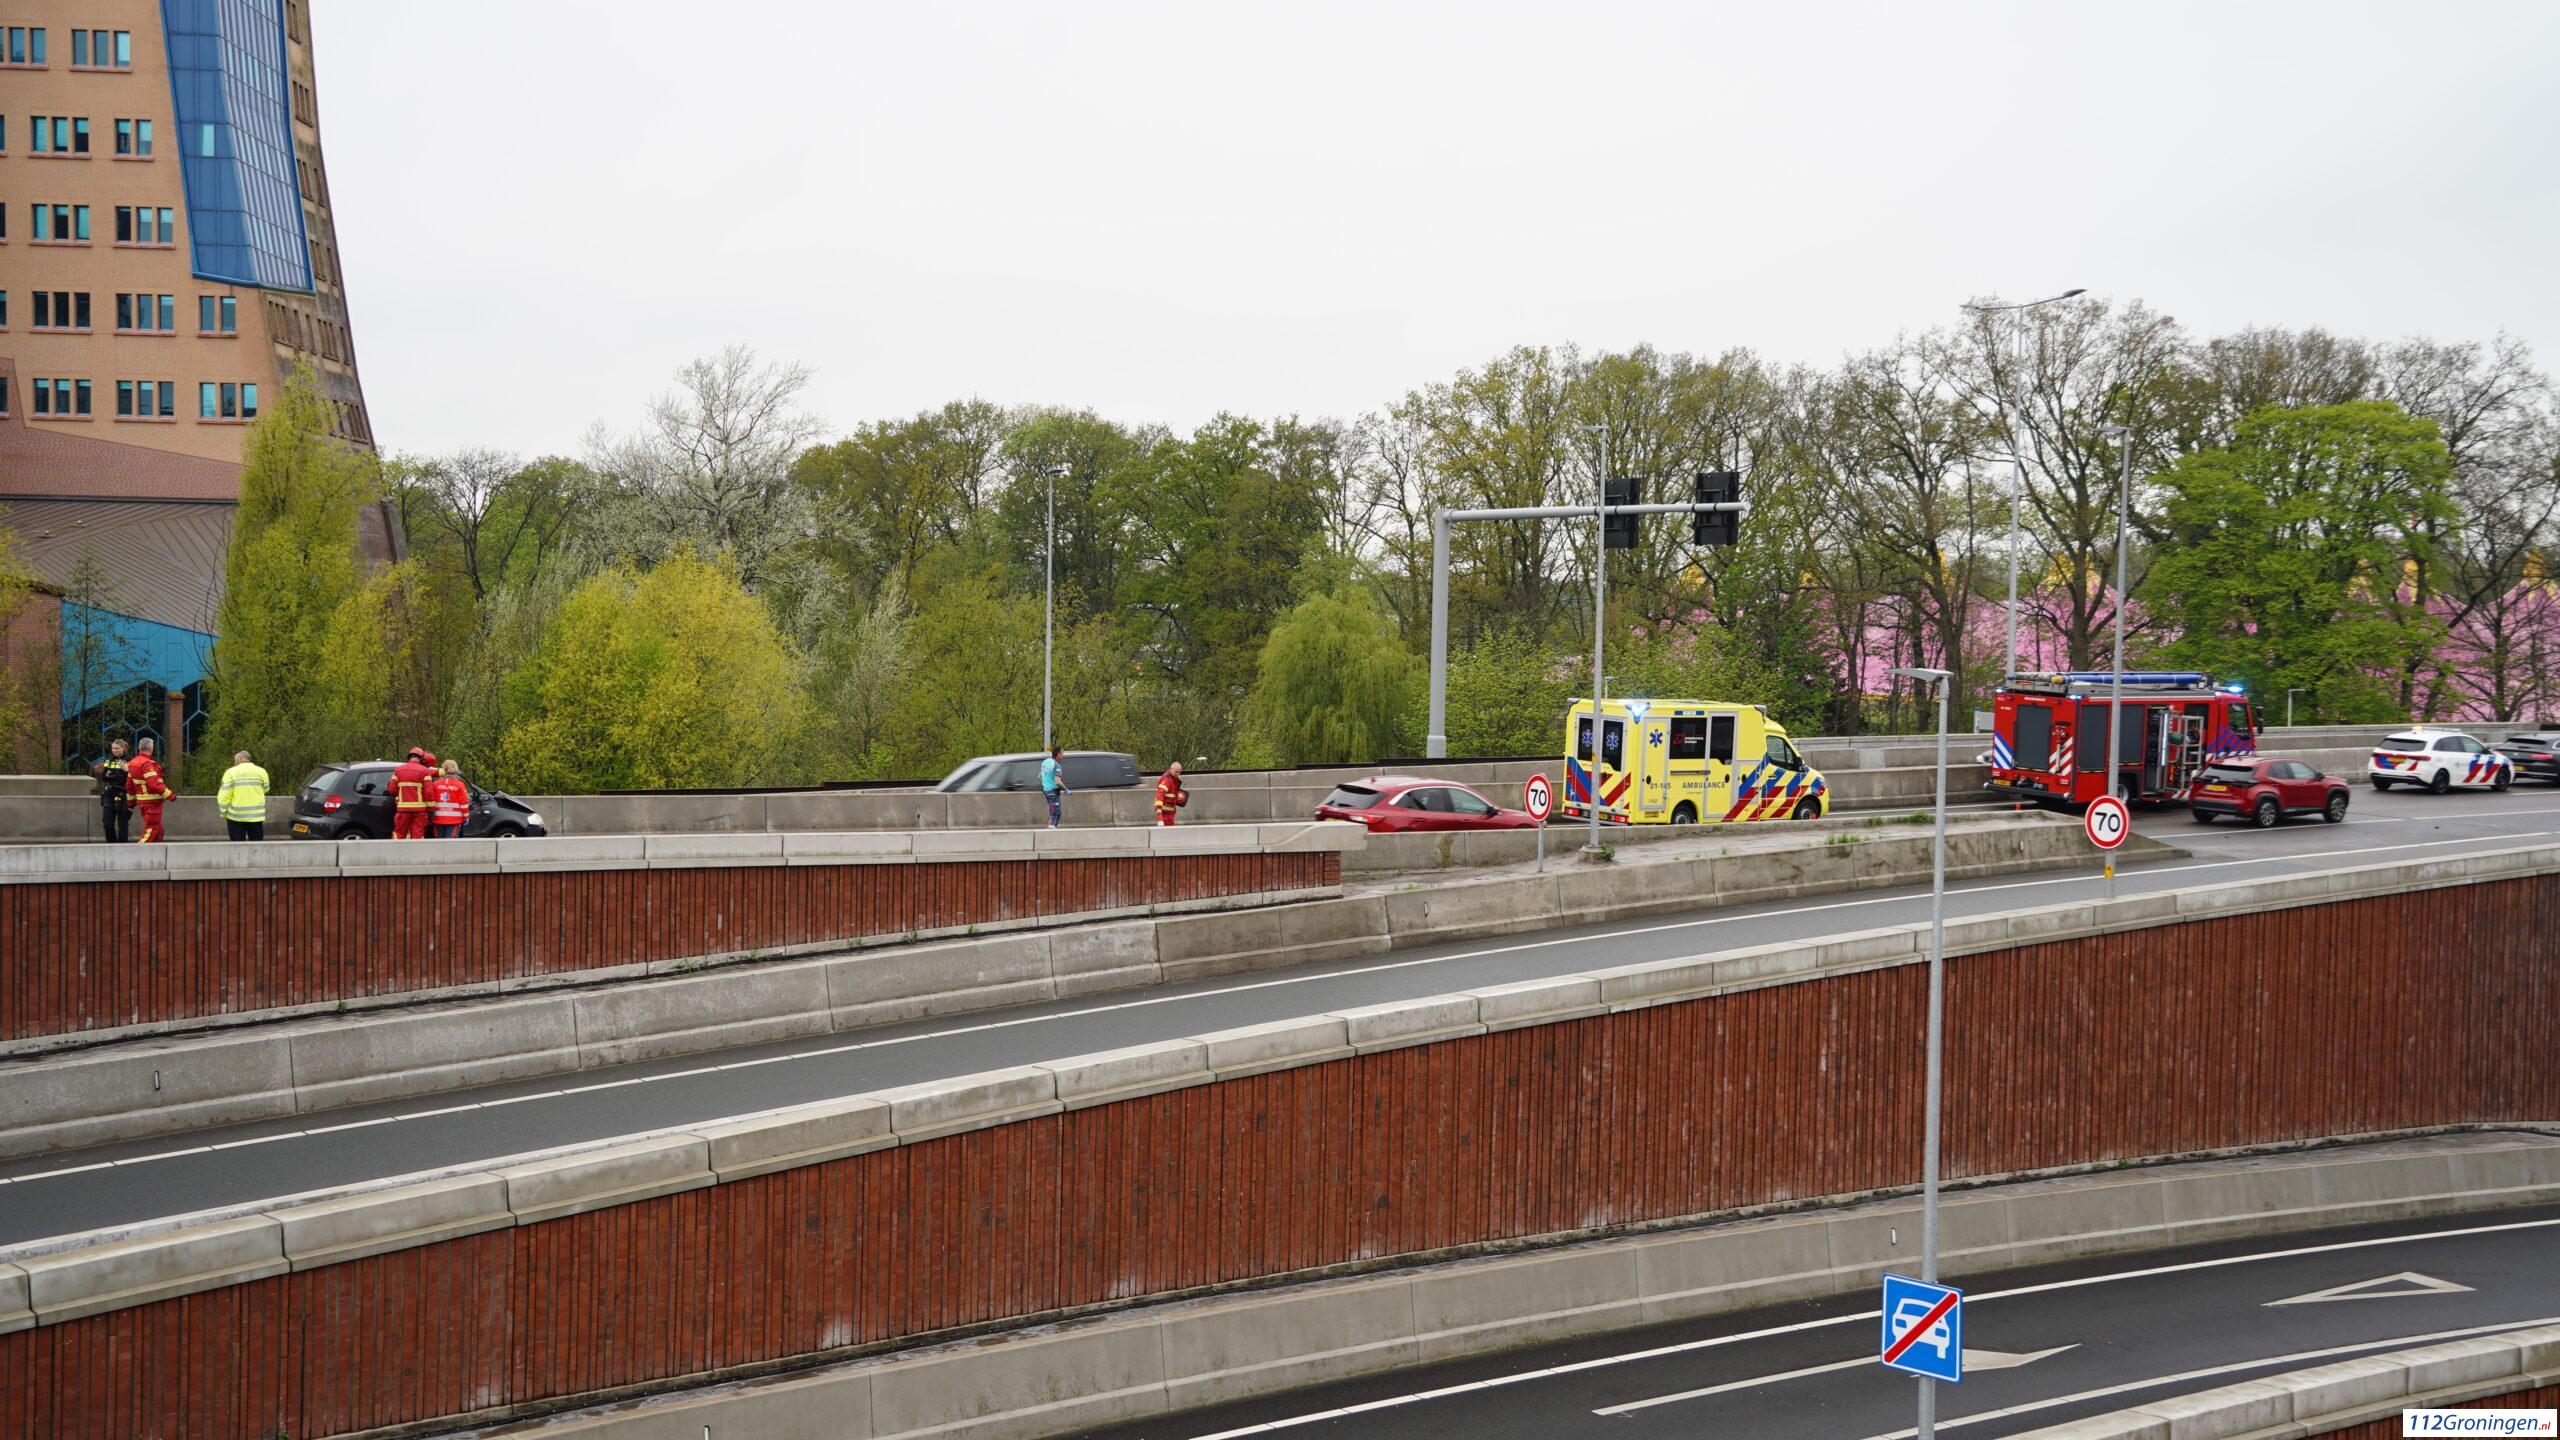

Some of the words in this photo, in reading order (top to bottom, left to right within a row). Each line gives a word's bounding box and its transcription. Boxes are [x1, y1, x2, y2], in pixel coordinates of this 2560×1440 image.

[1682, 781, 1726, 789] AMBULANCE
[1530, 788, 1547, 807] 70
[2095, 811, 2121, 833] 70
